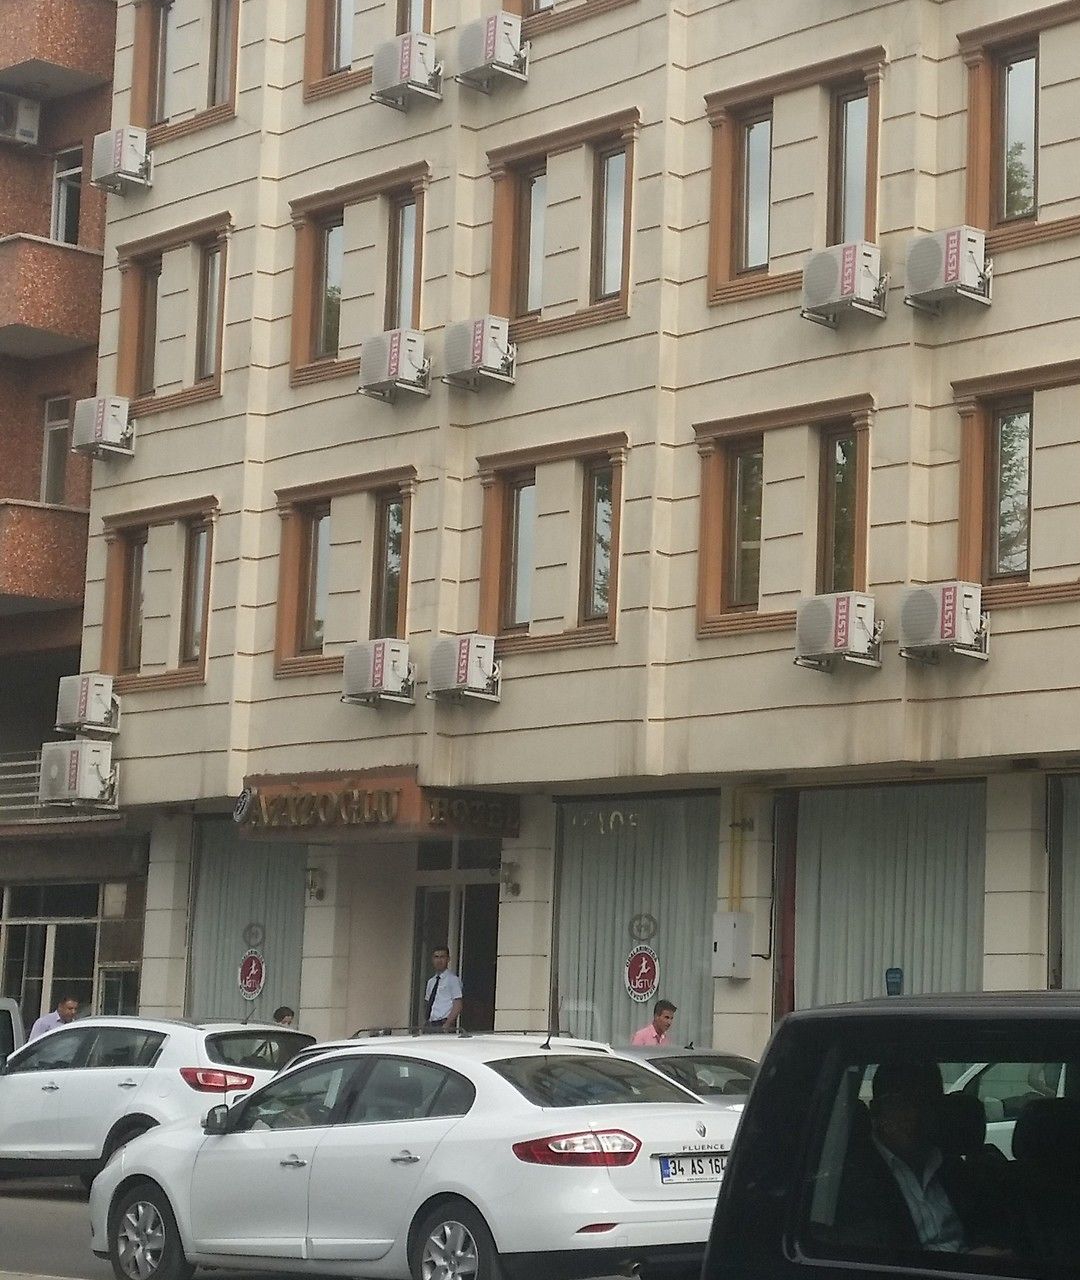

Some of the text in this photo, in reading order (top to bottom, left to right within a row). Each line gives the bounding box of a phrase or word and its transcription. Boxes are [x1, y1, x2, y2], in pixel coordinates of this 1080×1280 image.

[843, 243, 855, 293] VESTEL
[945, 231, 959, 282] VESTEL
[836, 597, 848, 647] VESTEL
[941, 585, 955, 638] VESTEL
[670, 1160, 684, 1176] 34
[691, 1158, 704, 1175] AS
[682, 1143, 725, 1151] FLUENCE
